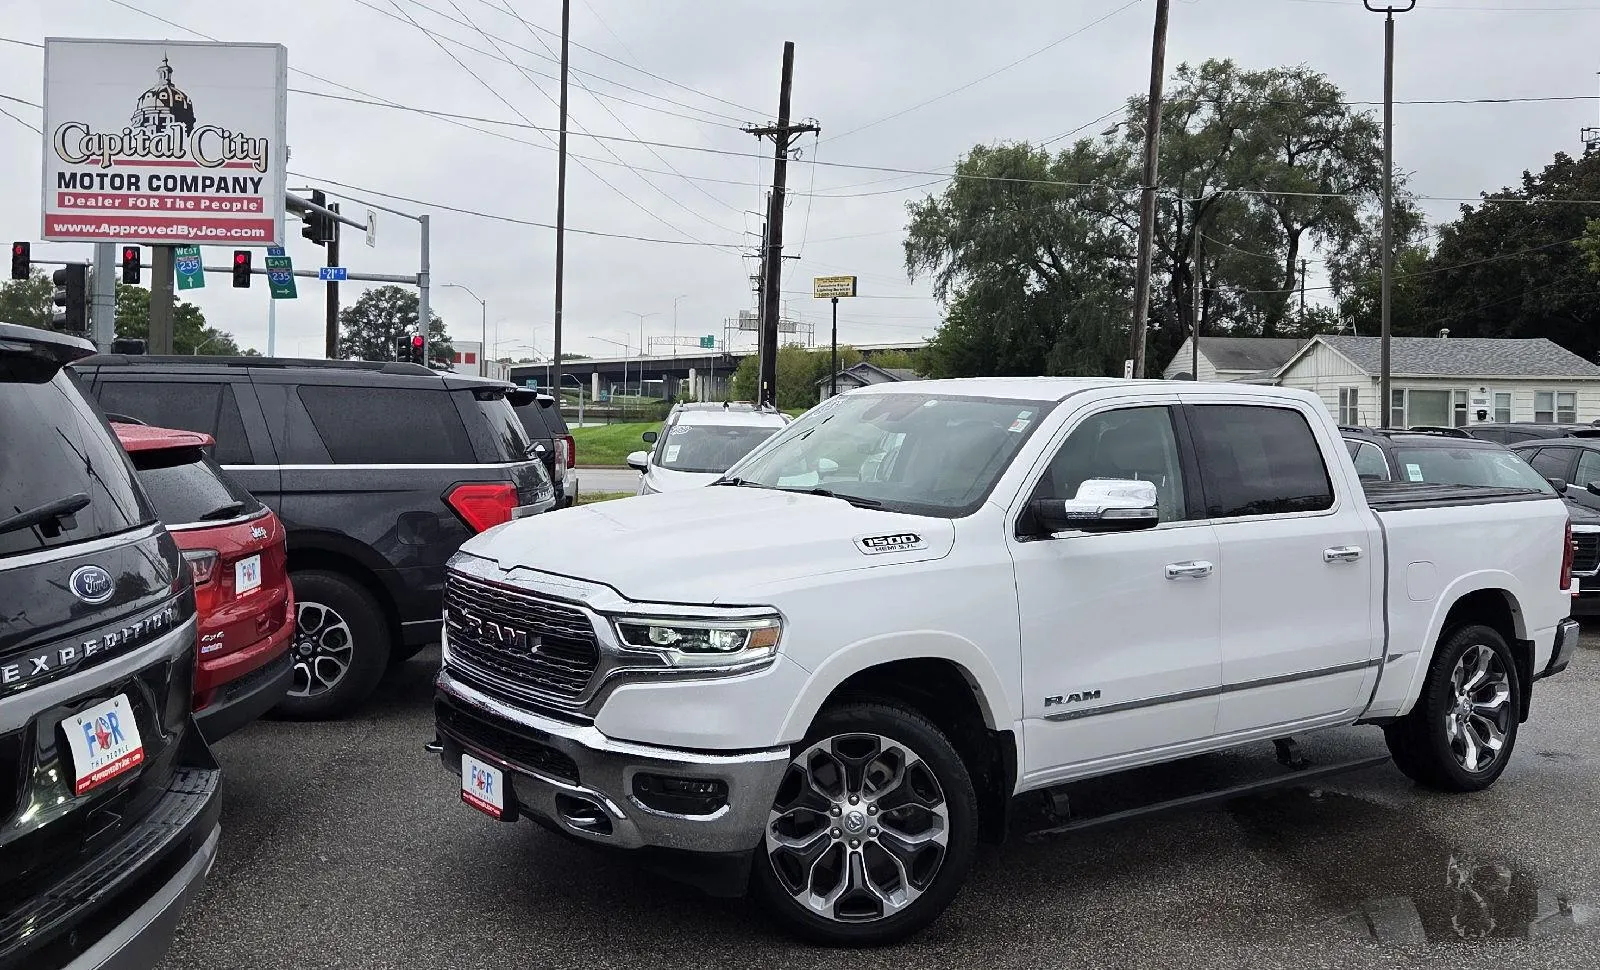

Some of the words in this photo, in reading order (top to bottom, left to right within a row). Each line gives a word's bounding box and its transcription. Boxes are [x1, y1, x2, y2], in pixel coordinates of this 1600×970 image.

[54, 121, 187, 169] Capital
[190, 125, 268, 173] City
[57, 171, 141, 191] MOTOR
[147, 174, 263, 194] COMPANY
[64, 195, 122, 207] Dealer
[128, 197, 160, 208] FOR
[165, 198, 195, 209] The
[53, 222, 265, 238] www.ApprovedByJoe.com
[176, 247, 198, 255] WEST
[180, 261, 198, 271] 235
[268, 259, 289, 267] EAST
[272, 272, 290, 280] 235
[863, 534, 919, 547] 1500
[83, 572, 108, 594] Ford
[465, 613, 528, 649] RAM
[1, 607, 173, 684] EXPEDITION
[1044, 689, 1102, 707] RAM
[82, 711, 126, 759] FOR
[91, 758, 104, 770] THE
[106, 744, 129, 760] PEOPLE
[471, 765, 494, 796] FOR
